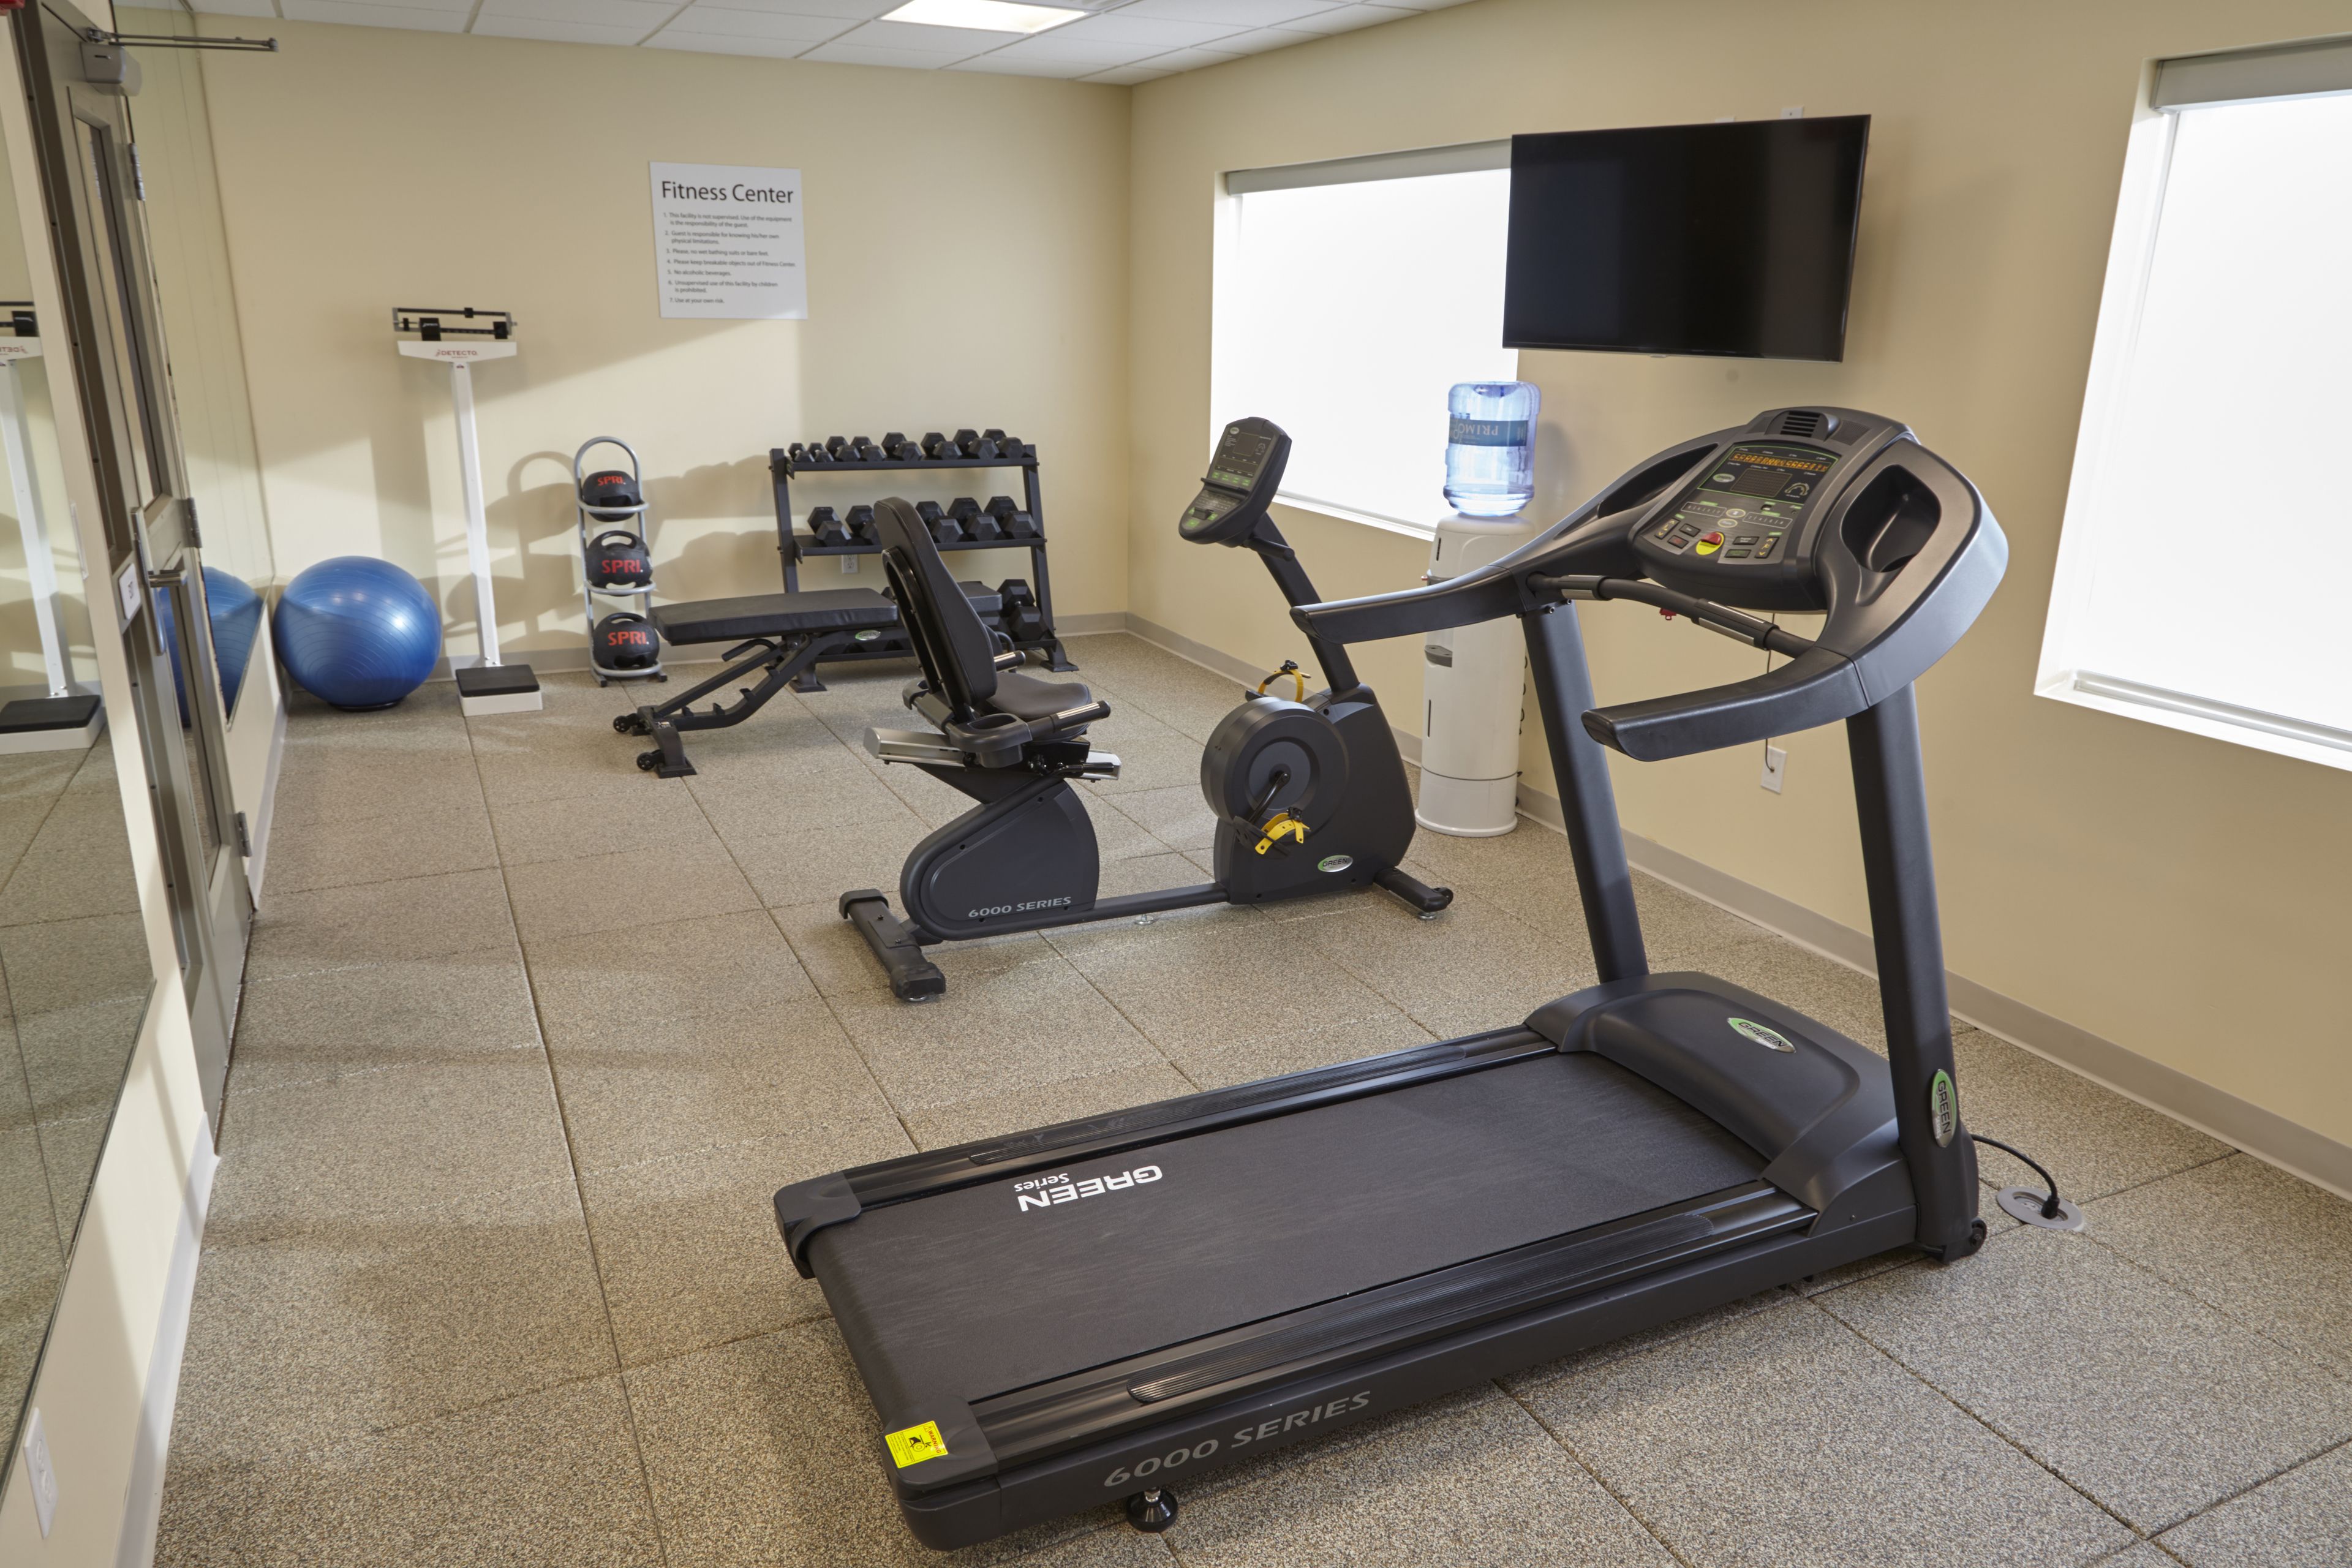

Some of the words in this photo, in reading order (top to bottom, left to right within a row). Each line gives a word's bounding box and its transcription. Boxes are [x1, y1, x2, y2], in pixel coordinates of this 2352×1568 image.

[662, 181, 727, 201] Fitness
[732, 184, 794, 203] Center
[1458, 423, 1499, 435] PRIMO
[1322, 858, 1348, 867] GREEN
[968, 905, 1012, 918] 6000
[1016, 896, 1071, 912] SERIES
[1738, 1022, 1789, 1047] GREEN
[1937, 1080, 1951, 1134] GREEN
[1014, 1173, 1070, 1192] Series
[1017, 1165, 1163, 1212] GREEN
[927, 1430, 941, 1454] WARNING
[1104, 1439, 1219, 1487] 6000
[1231, 1391, 1371, 1449] SERIES
